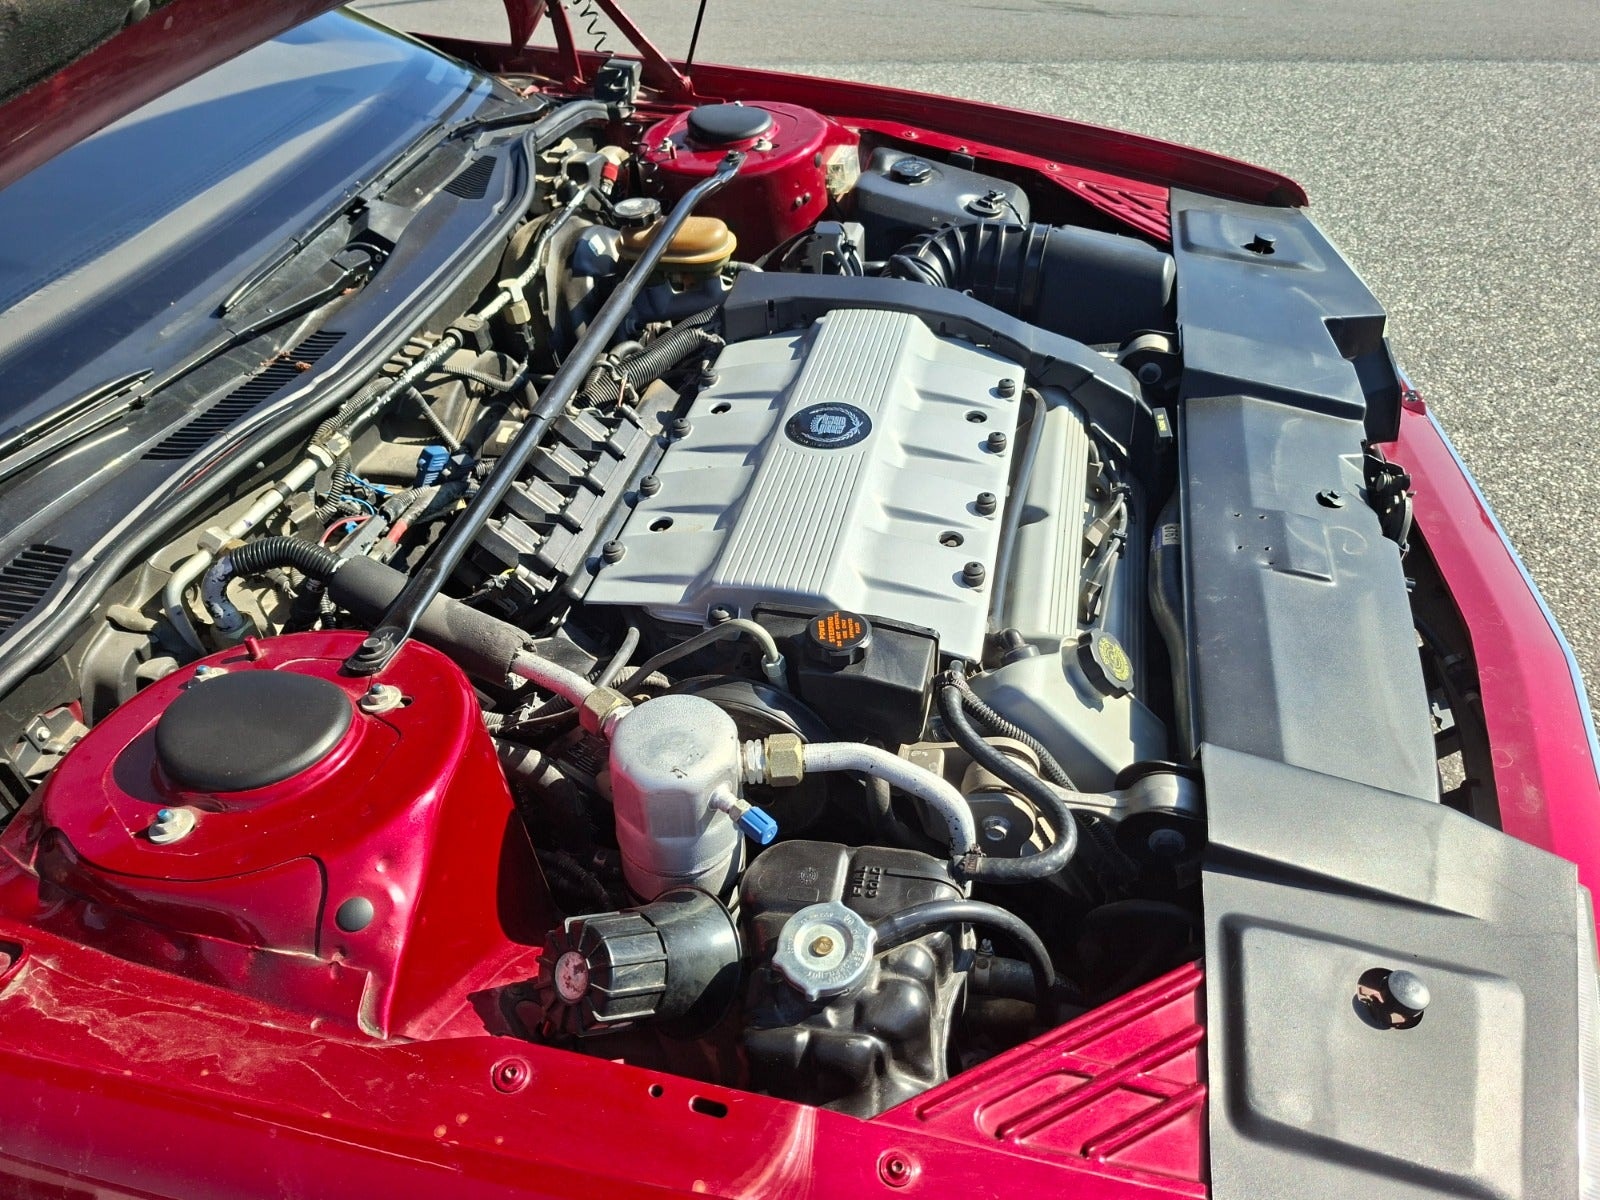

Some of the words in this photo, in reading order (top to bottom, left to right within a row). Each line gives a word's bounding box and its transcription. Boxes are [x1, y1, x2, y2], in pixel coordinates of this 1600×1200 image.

[818, 620, 826, 640] POWER
[827, 616, 835, 642] STEERING
[852, 865, 869, 898] FULL
[864, 866, 882, 899] COLD
